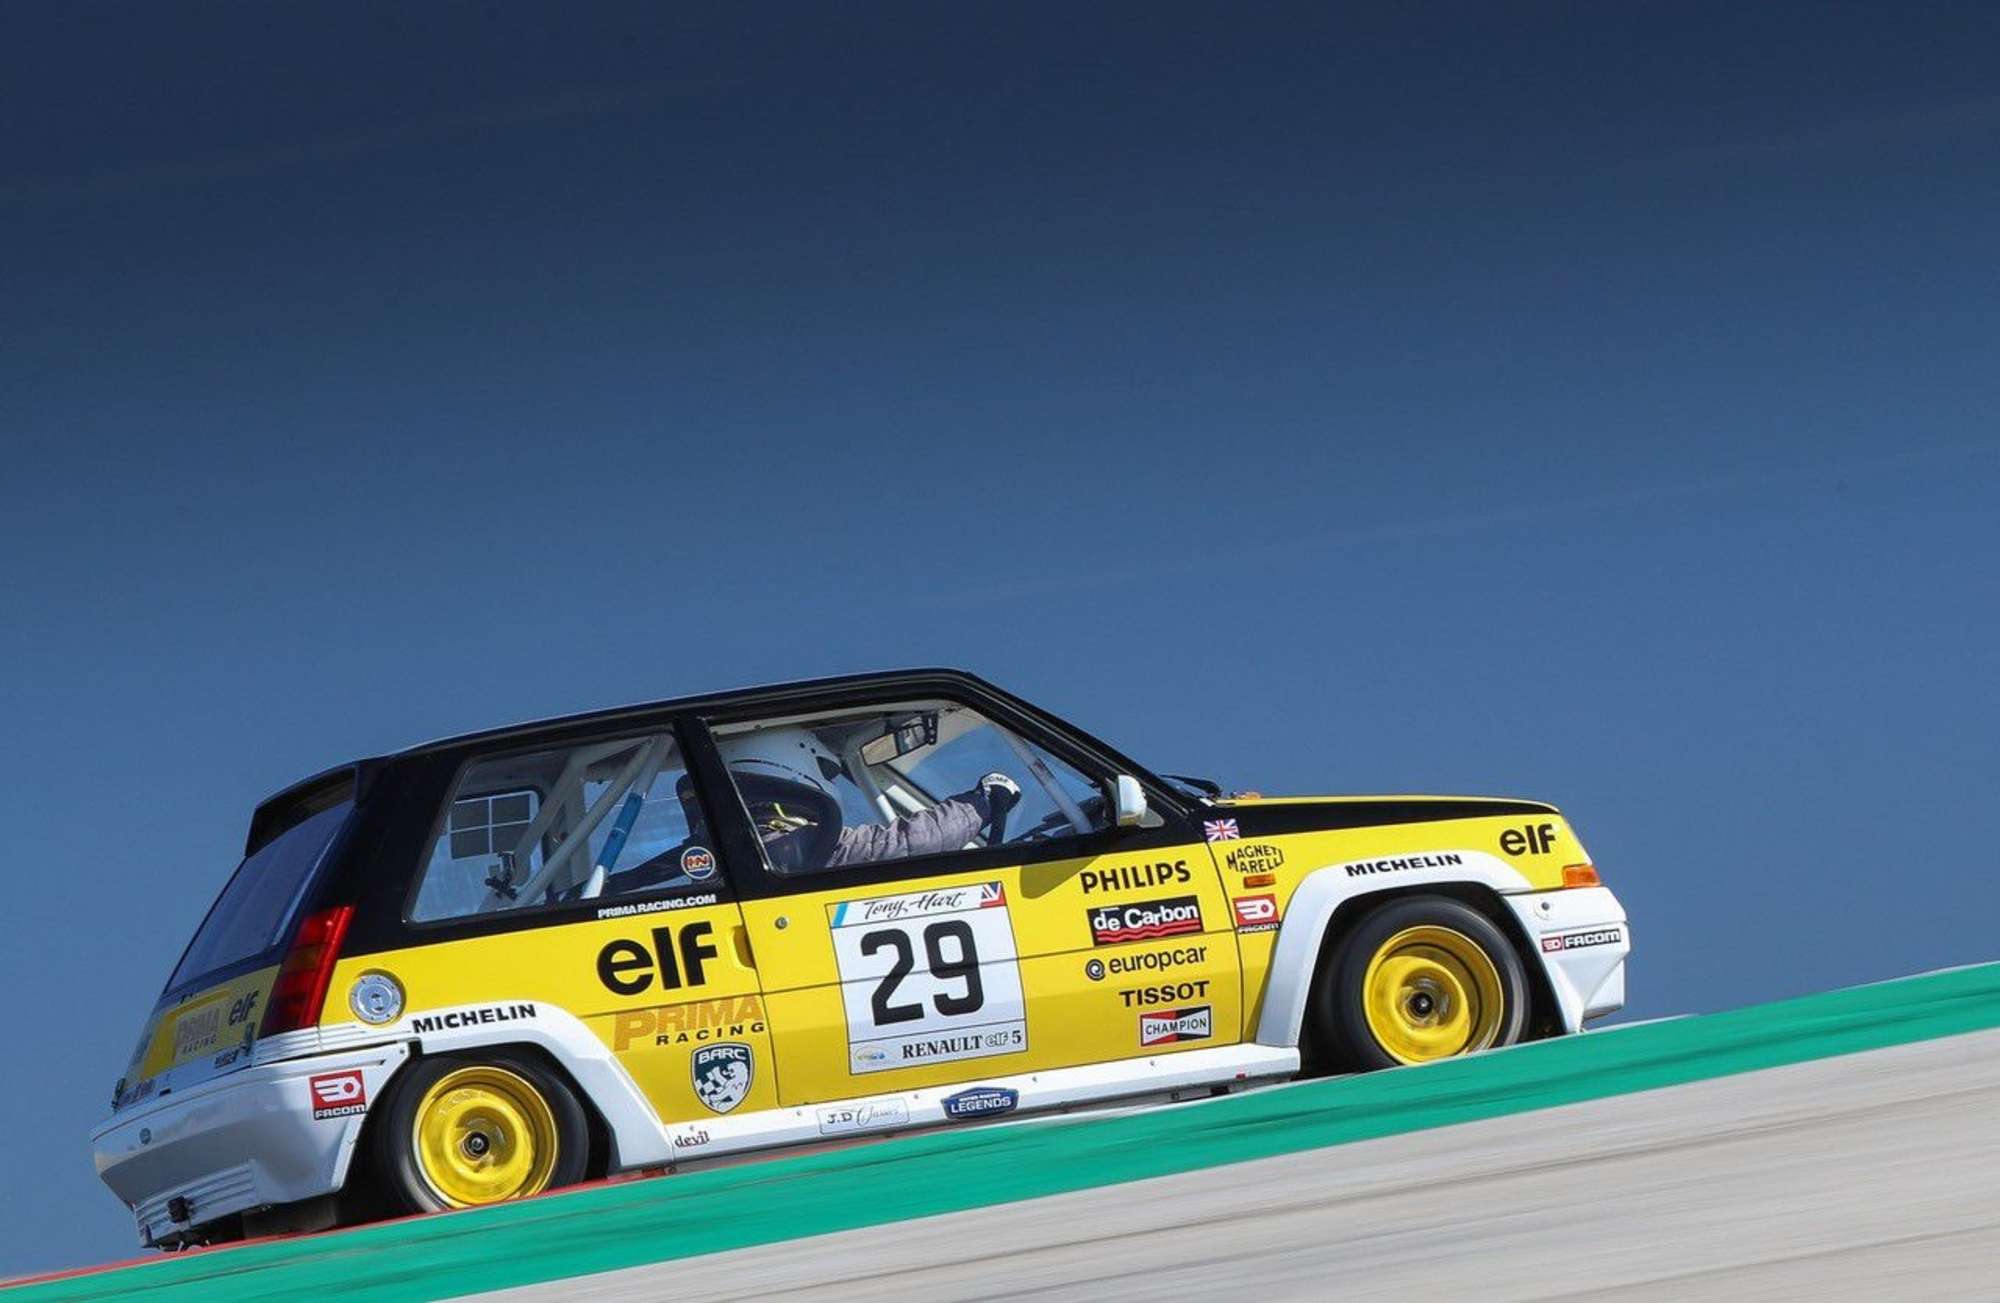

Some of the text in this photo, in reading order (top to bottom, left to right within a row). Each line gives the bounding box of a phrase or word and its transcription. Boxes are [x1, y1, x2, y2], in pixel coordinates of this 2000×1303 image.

[1499, 823, 1556, 856] elf
[1080, 860, 1191, 894] PHILIPS
[1345, 854, 1463, 877] MICHELIN
[1093, 905, 1198, 931] de Carbon
[596, 920, 718, 996] elf
[1109, 946, 1207, 974] europcar
[860, 919, 984, 1026] 29
[1118, 981, 1210, 1007] TISSOT
[412, 1004, 537, 1034] MICHELIN
[613, 995, 764, 1051] PRIMA
[1145, 1017, 1207, 1035] CHAMPION
[656, 1022, 764, 1046] RACING
[902, 1035, 982, 1059] RENAULT
[985, 1032, 1009, 1047] elf
[1012, 1030, 1022, 1044] 5
[698, 1048, 747, 1064] BARC
[951, 1096, 1012, 1113] LEGENDS
[674, 1131, 711, 1148] devil
